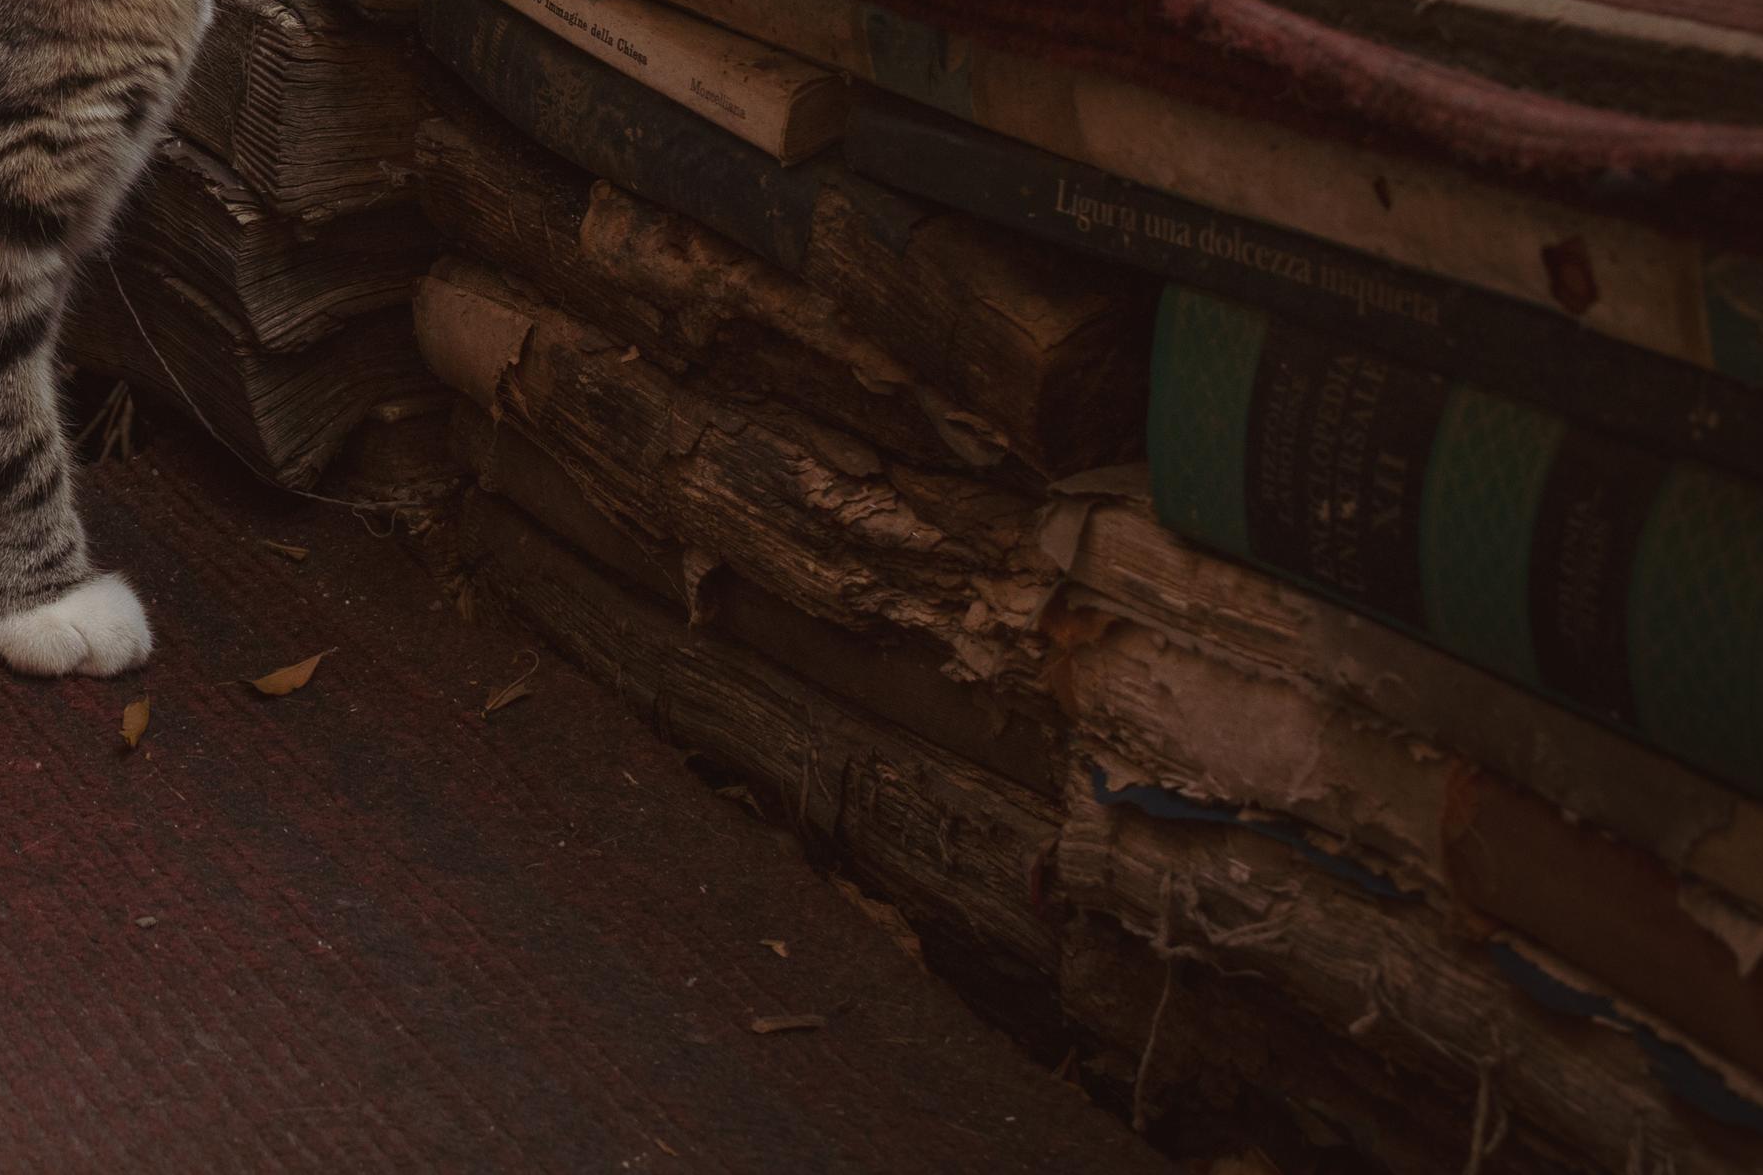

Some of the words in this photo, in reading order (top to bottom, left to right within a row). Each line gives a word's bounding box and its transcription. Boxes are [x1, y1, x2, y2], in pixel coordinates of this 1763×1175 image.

[590, 24, 614, 47] della
[617, 38, 648, 66] Chiesa
[1144, 209, 1193, 248] una
[1198, 218, 1313, 286] dolcezza
[1319, 262, 1440, 325] inquieta
[1371, 446, 1412, 539] XII
